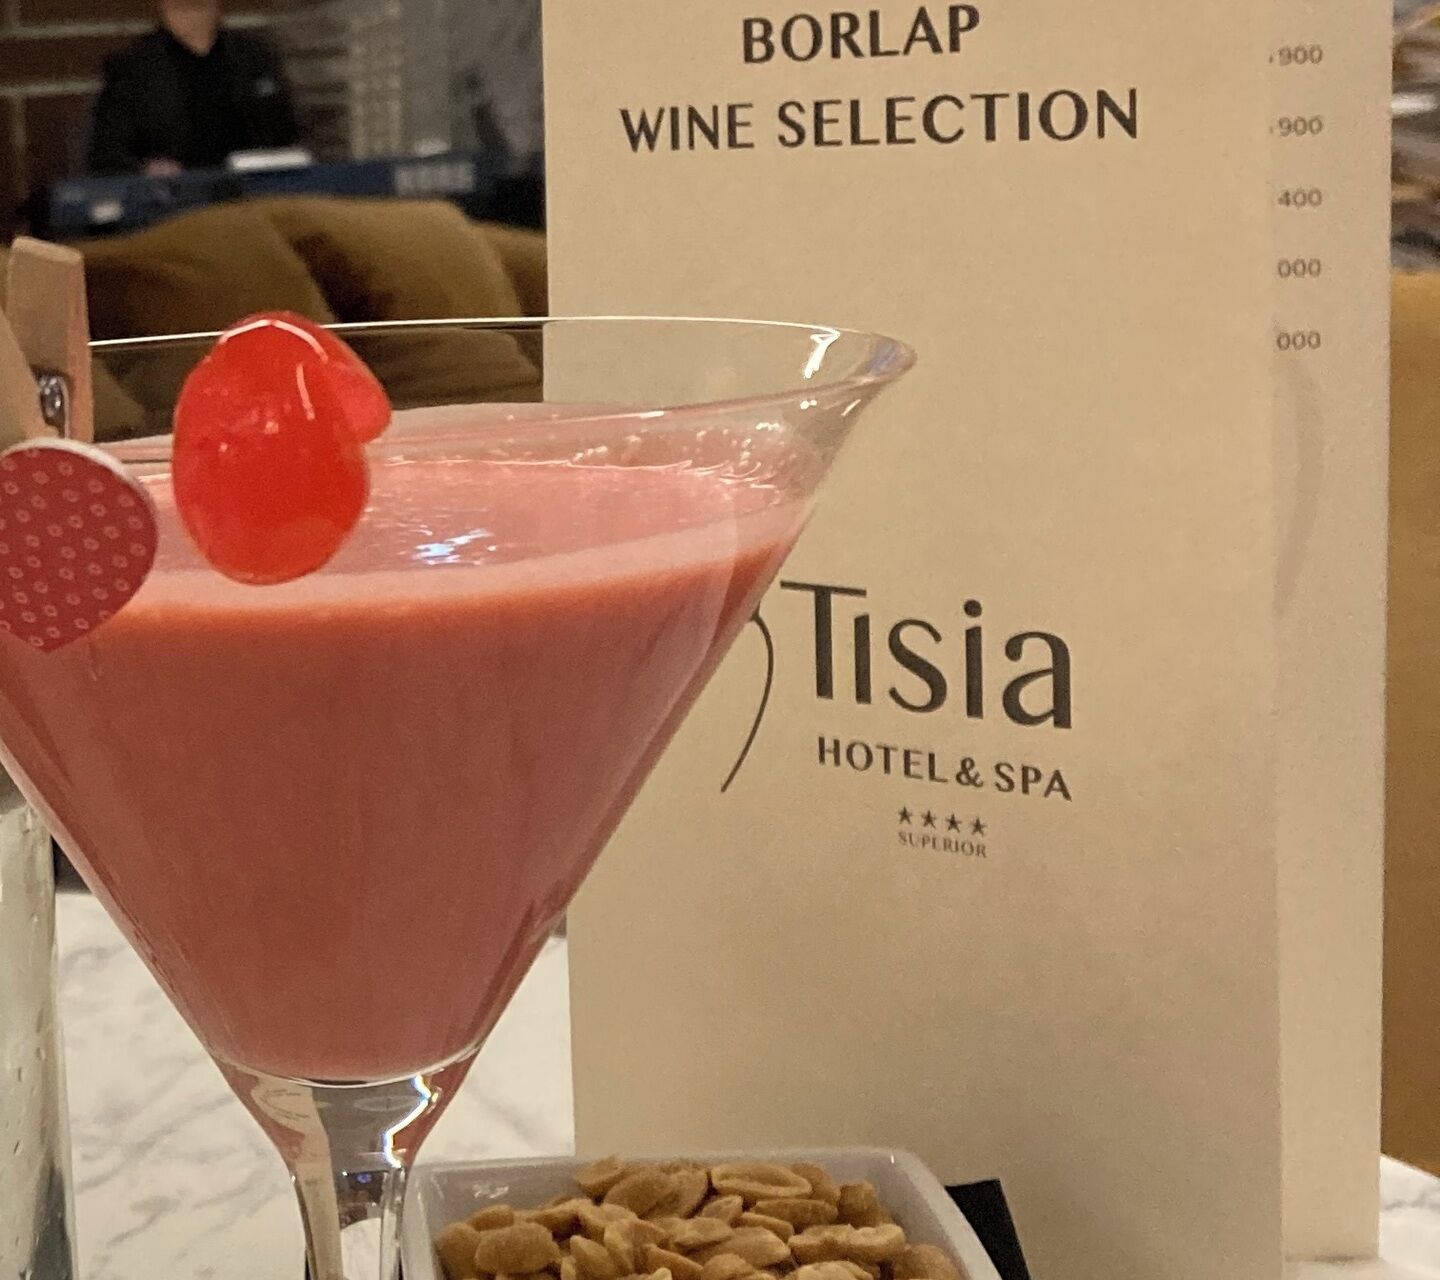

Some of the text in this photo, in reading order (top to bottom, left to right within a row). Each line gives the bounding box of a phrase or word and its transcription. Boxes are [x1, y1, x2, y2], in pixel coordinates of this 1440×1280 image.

[741, 3, 980, 65] BORLAP
[619, 87, 1138, 153] WINE SELECTION
[779, 580, 1073, 730] Tisia
[898, 831, 987, 858] SUPERIOR
